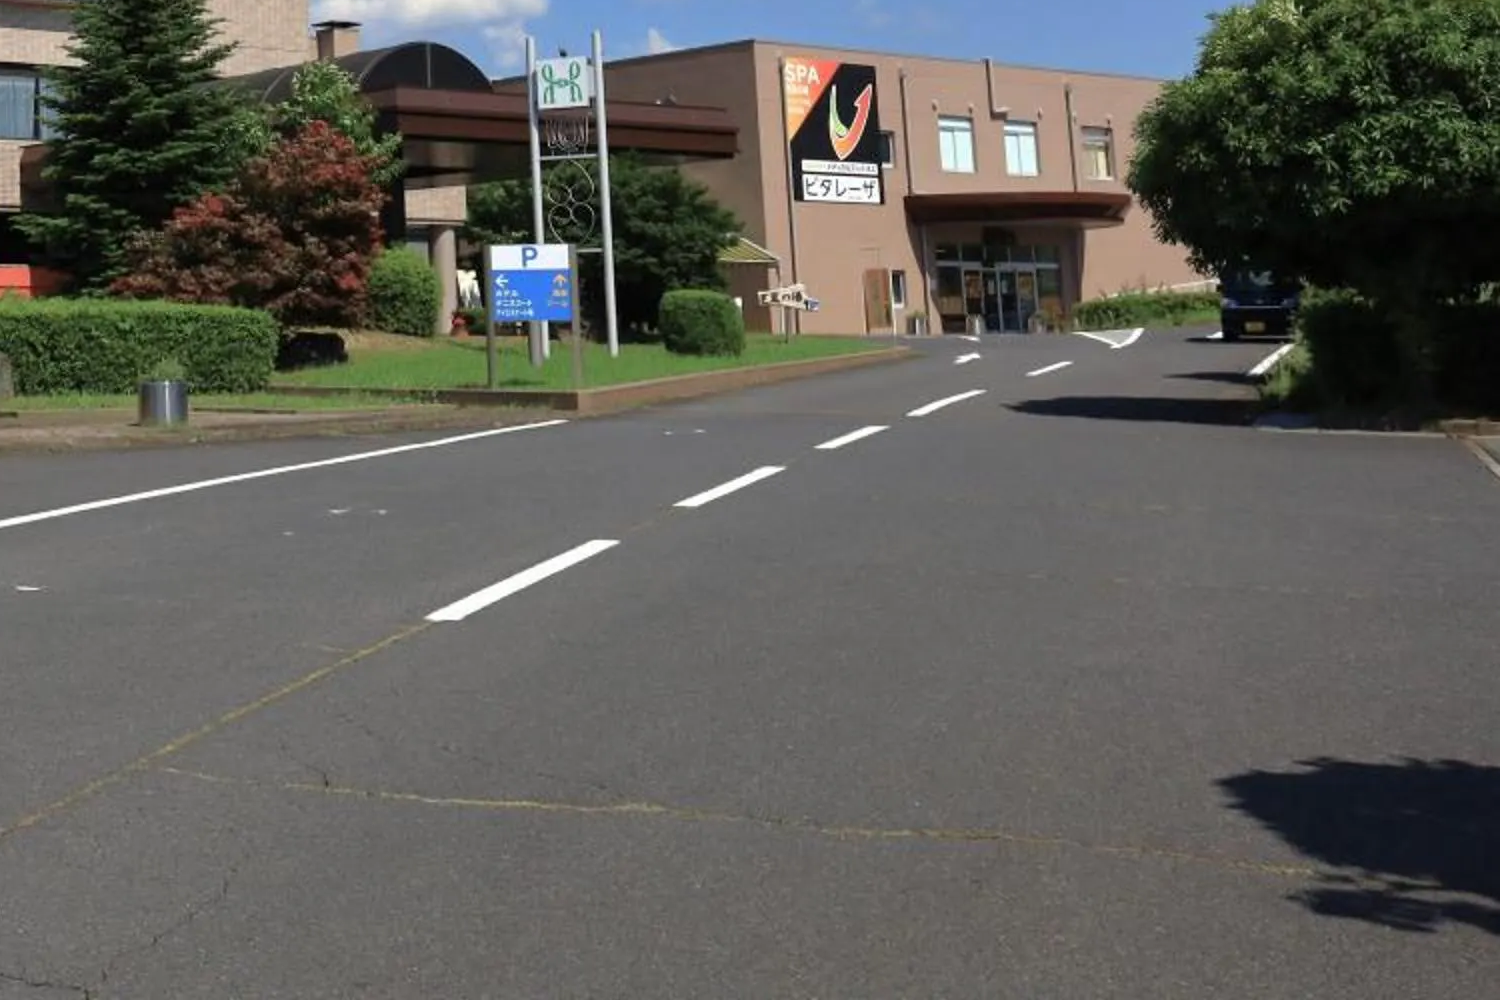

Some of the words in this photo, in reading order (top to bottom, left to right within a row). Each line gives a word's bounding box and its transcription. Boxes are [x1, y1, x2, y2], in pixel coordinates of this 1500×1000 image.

[785, 64, 820, 85] SPA
[805, 177, 877, 199] ビタレーザ
[521, 246, 538, 267] P
